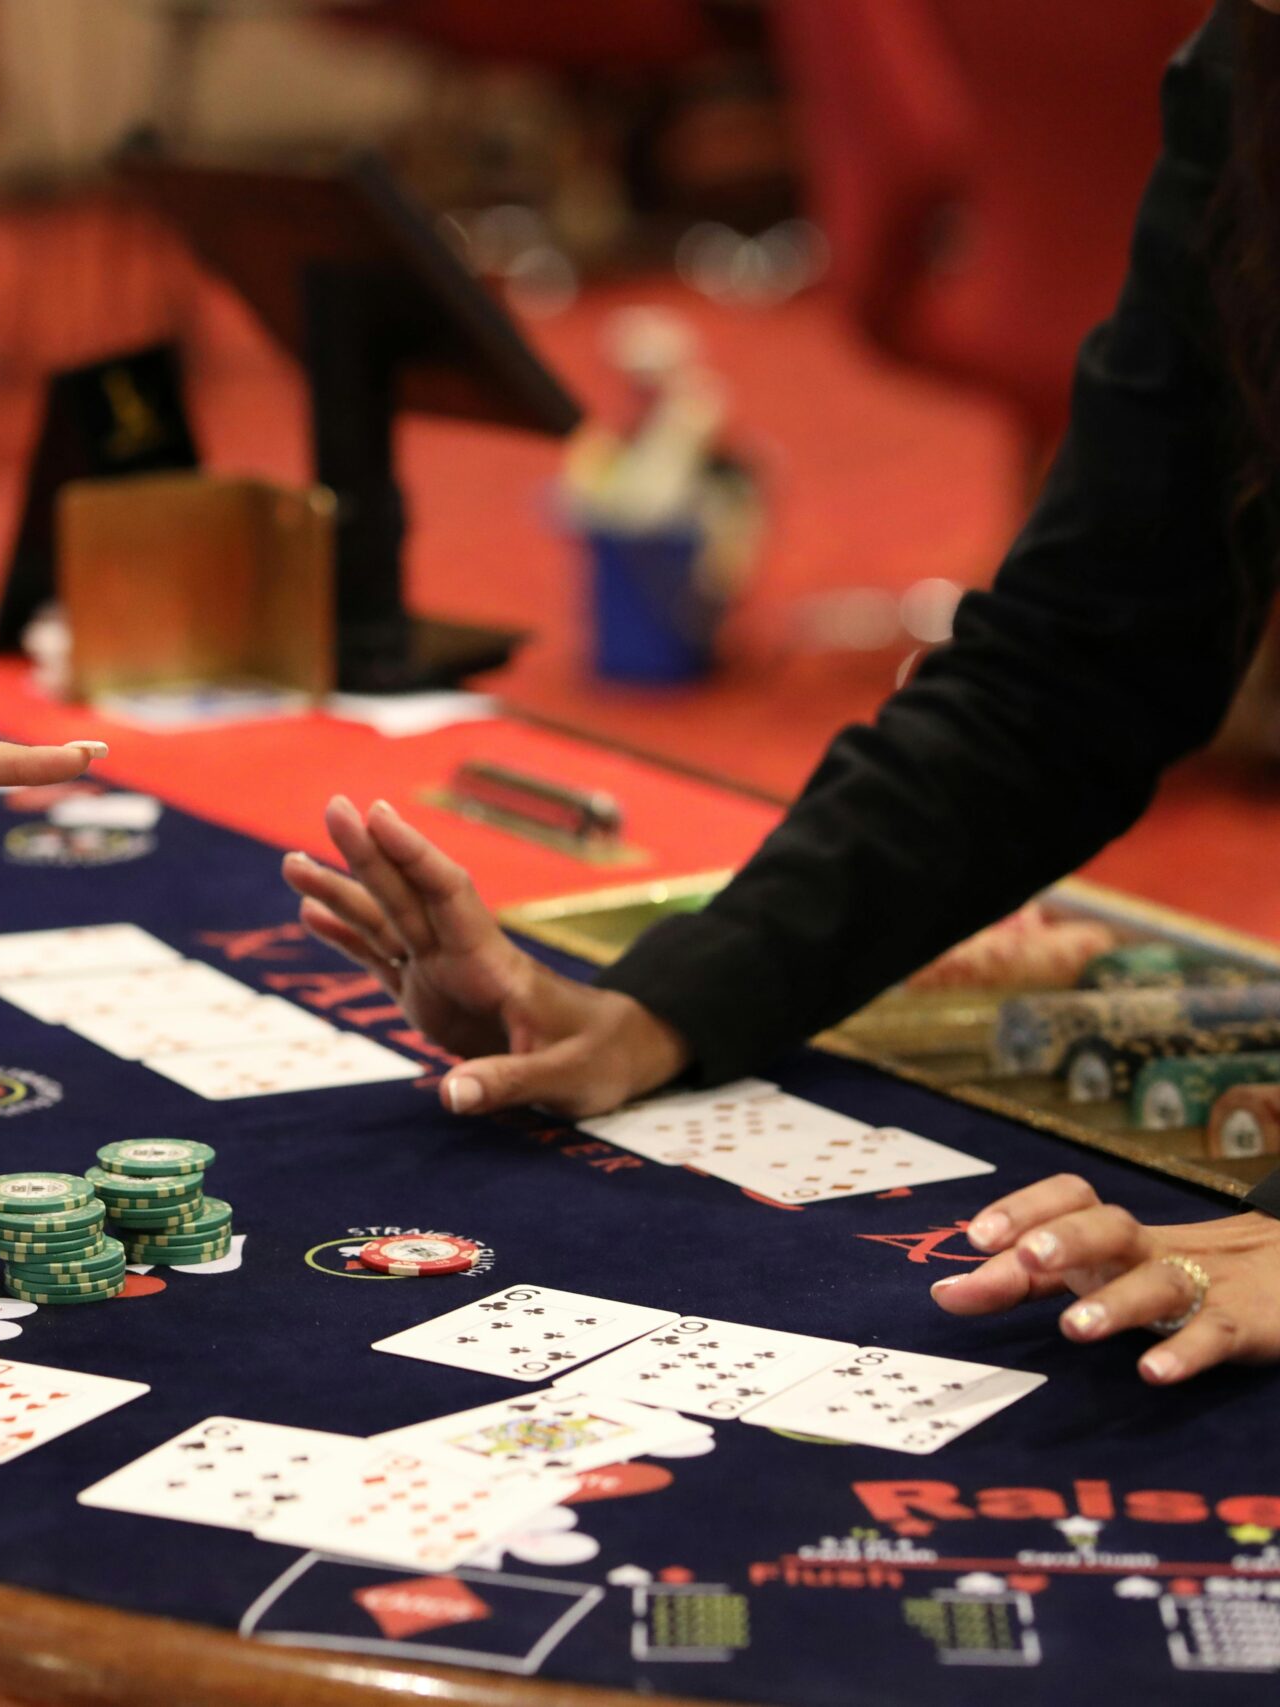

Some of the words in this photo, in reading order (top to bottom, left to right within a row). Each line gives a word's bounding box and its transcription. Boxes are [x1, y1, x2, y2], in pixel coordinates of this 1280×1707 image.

[504, 1289, 541, 1302] 6
[671, 1321, 709, 1335] 9
[854, 1352, 889, 1366] 8
[512, 1361, 550, 1375] 6
[852, 1480, 1280, 1530] Raise
